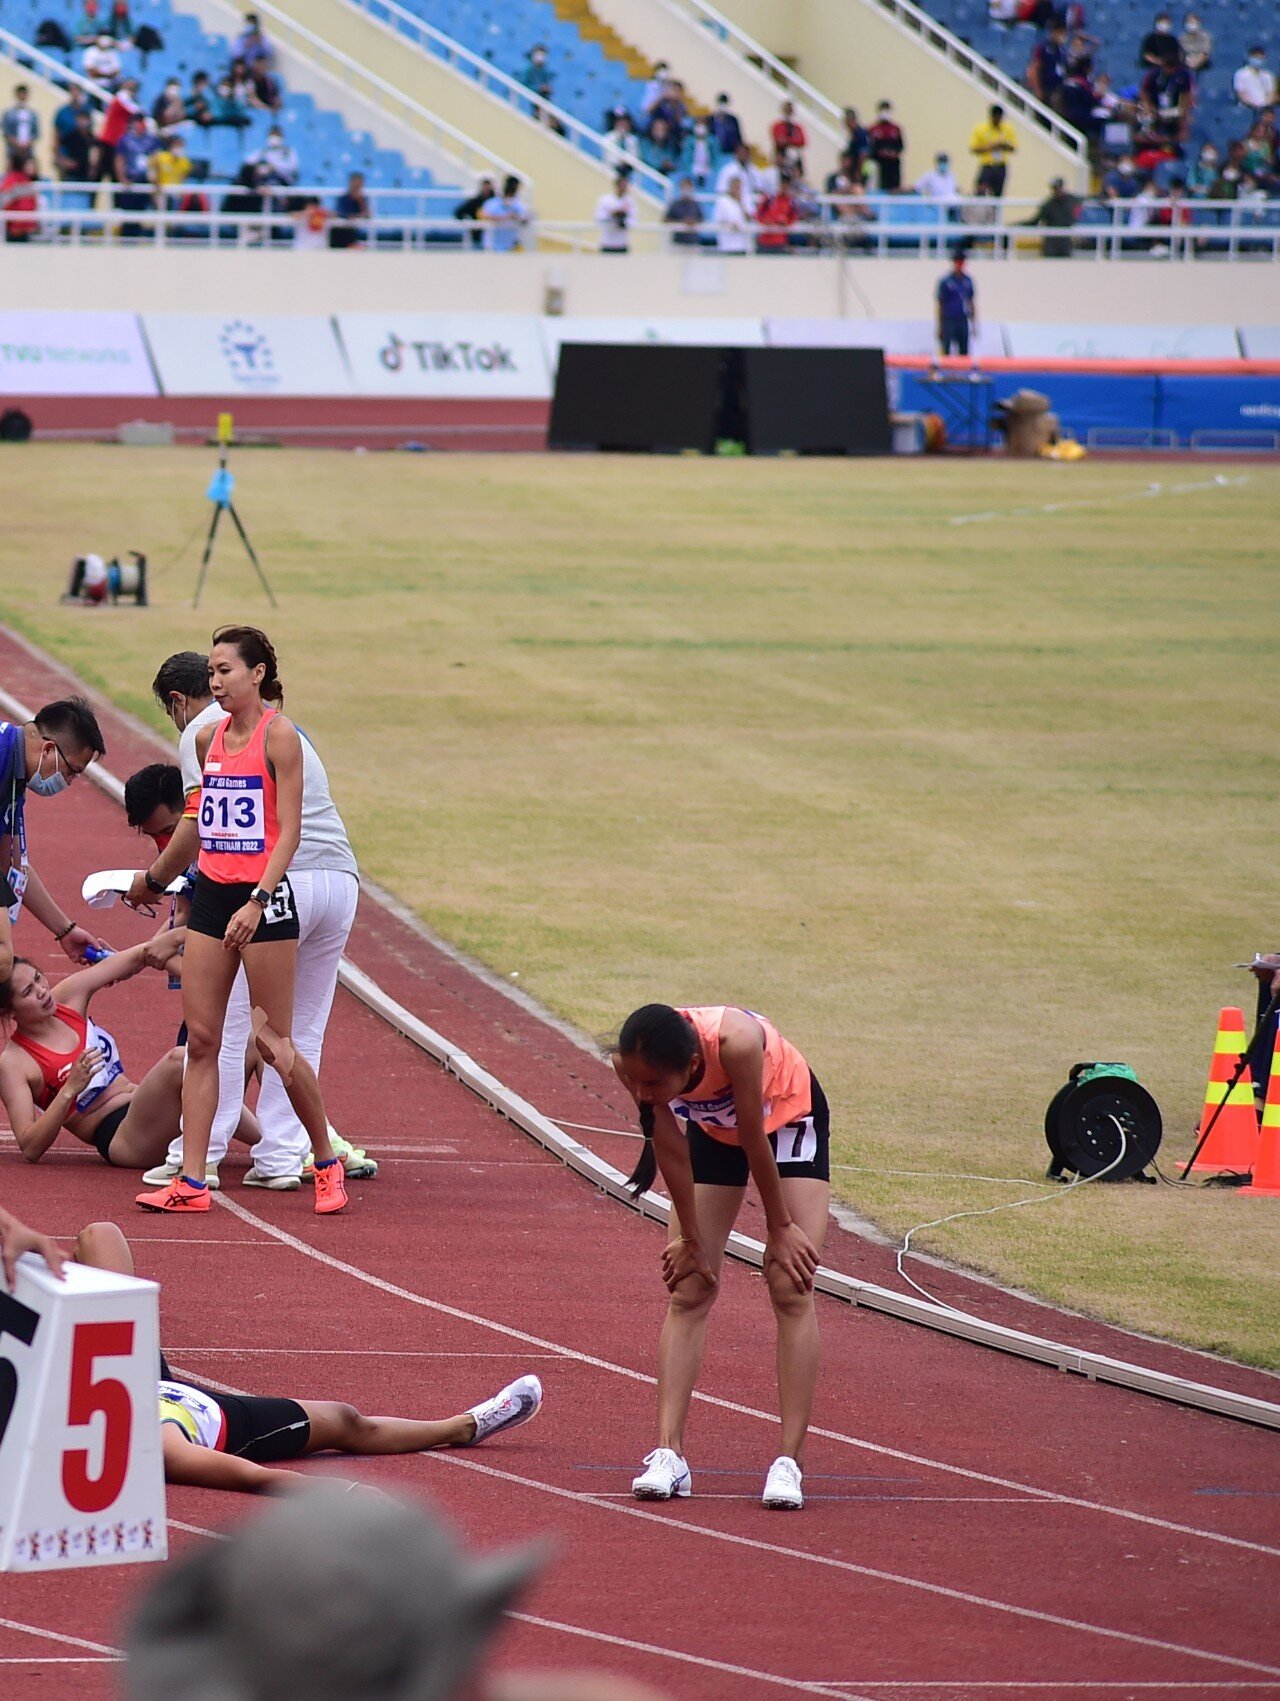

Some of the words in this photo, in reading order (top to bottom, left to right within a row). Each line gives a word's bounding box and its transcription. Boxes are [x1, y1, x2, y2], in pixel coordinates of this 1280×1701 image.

[411, 341, 519, 372] TikTok
[226, 778, 247, 788] Games
[201, 795, 256, 828] 613
[215, 841, 240, 851] VIETNAM
[242, 841, 258, 851] 2022
[785, 1121, 808, 1158] 7
[61, 1321, 135, 1513] 5
